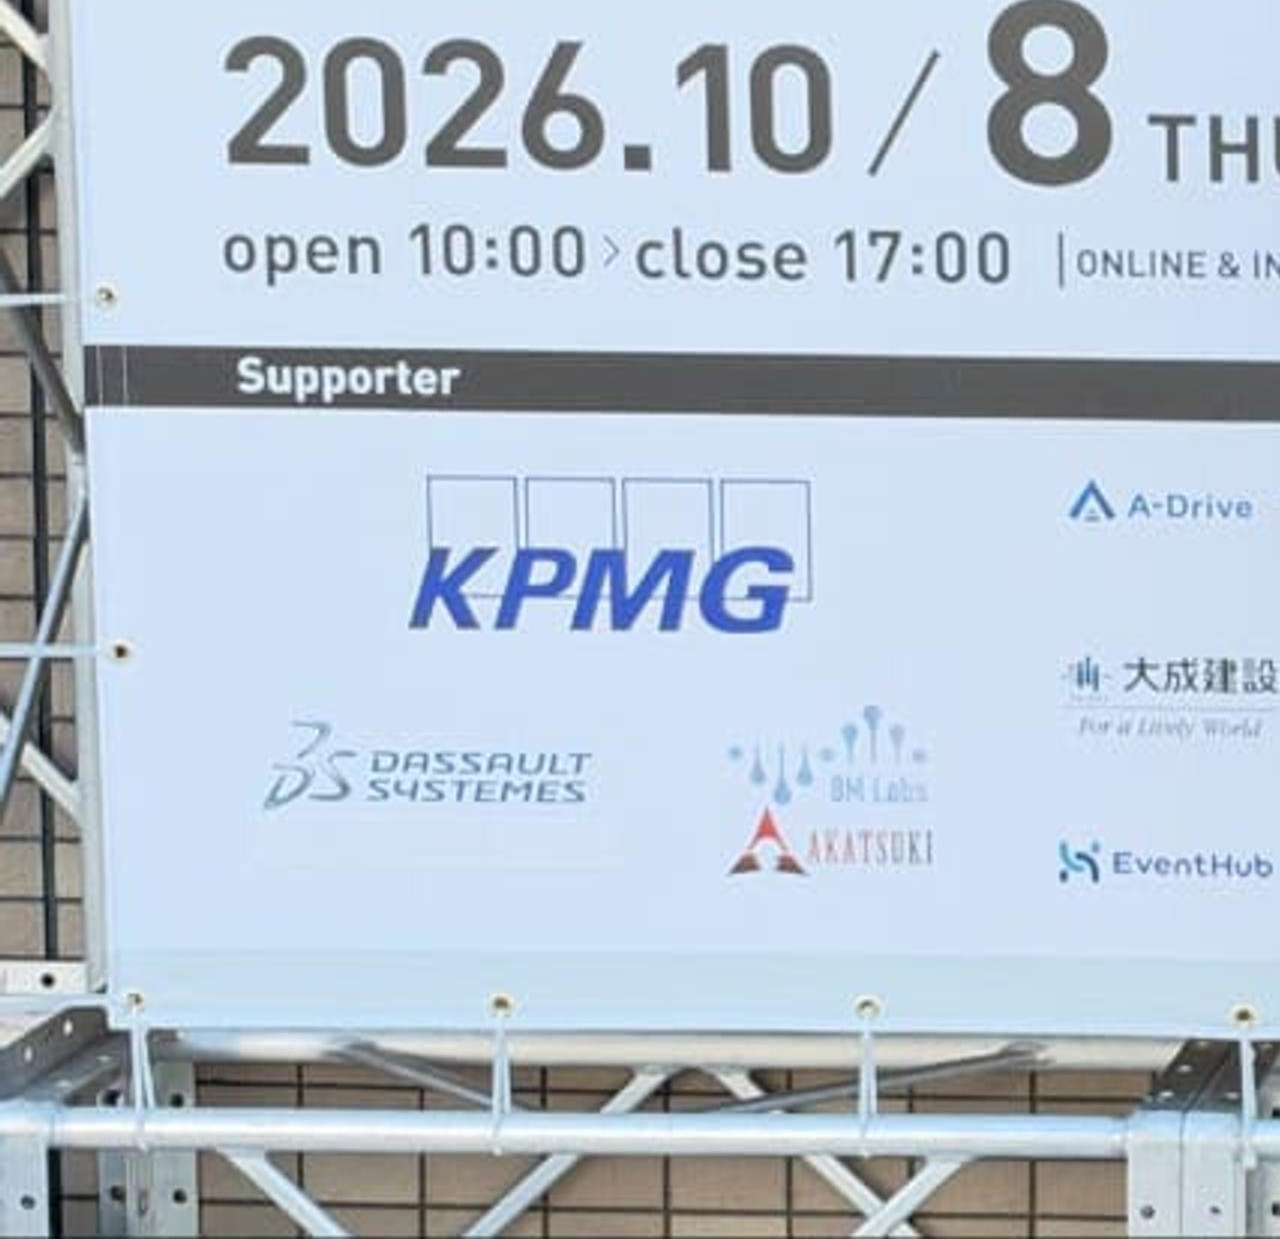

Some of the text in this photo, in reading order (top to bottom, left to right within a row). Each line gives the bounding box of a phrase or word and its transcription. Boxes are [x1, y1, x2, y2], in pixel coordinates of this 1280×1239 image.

[224, 34, 833, 174] 2026.10
[223, 235, 382, 286] open
[408, 223, 587, 277] 10:00
[636, 226, 808, 281] close
[833, 230, 1011, 284] 17:00
[1077, 250, 1206, 277] ONLINE
[1218, 250, 1241, 277] &
[236, 357, 461, 402] Supporter
[1128, 494, 1253, 519] A-Drive
[408, 546, 794, 633] KPMG
[1124, 657, 1278, 694] 大成建設
[370, 751, 592, 775] DASSAULT
[808, 828, 933, 866] AKATSUKI
[1112, 850, 1273, 879] EventHub
